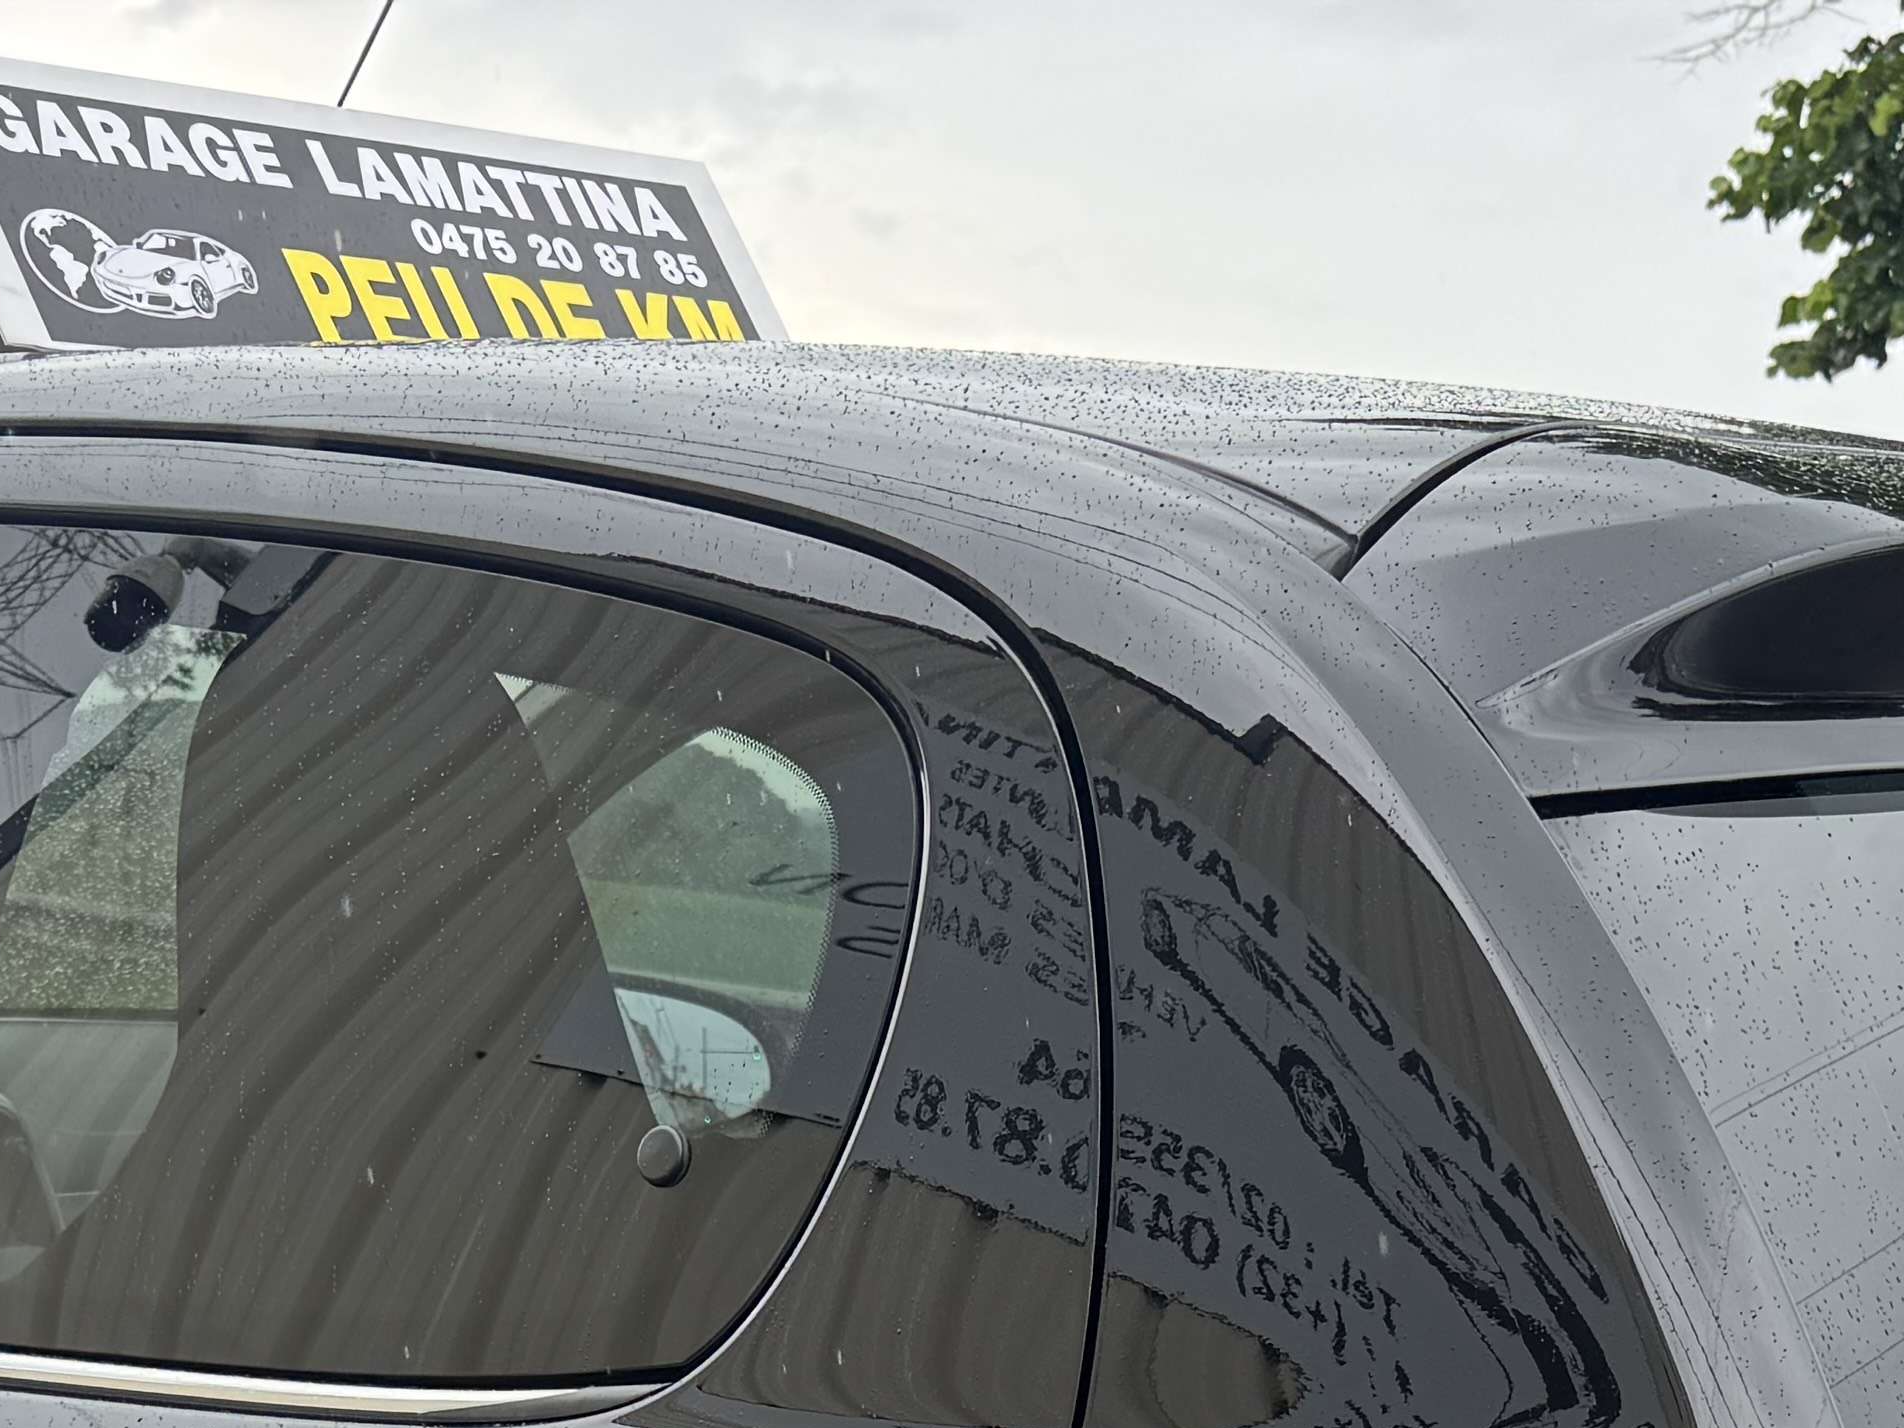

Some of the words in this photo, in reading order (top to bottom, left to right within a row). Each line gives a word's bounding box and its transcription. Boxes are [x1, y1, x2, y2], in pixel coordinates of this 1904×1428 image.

[304, 138, 688, 242] LAMATTINA
[410, 218, 517, 264] 0475
[527, 234, 583, 272] 20
[593, 242, 640, 279] 87
[653, 250, 707, 287] 85
